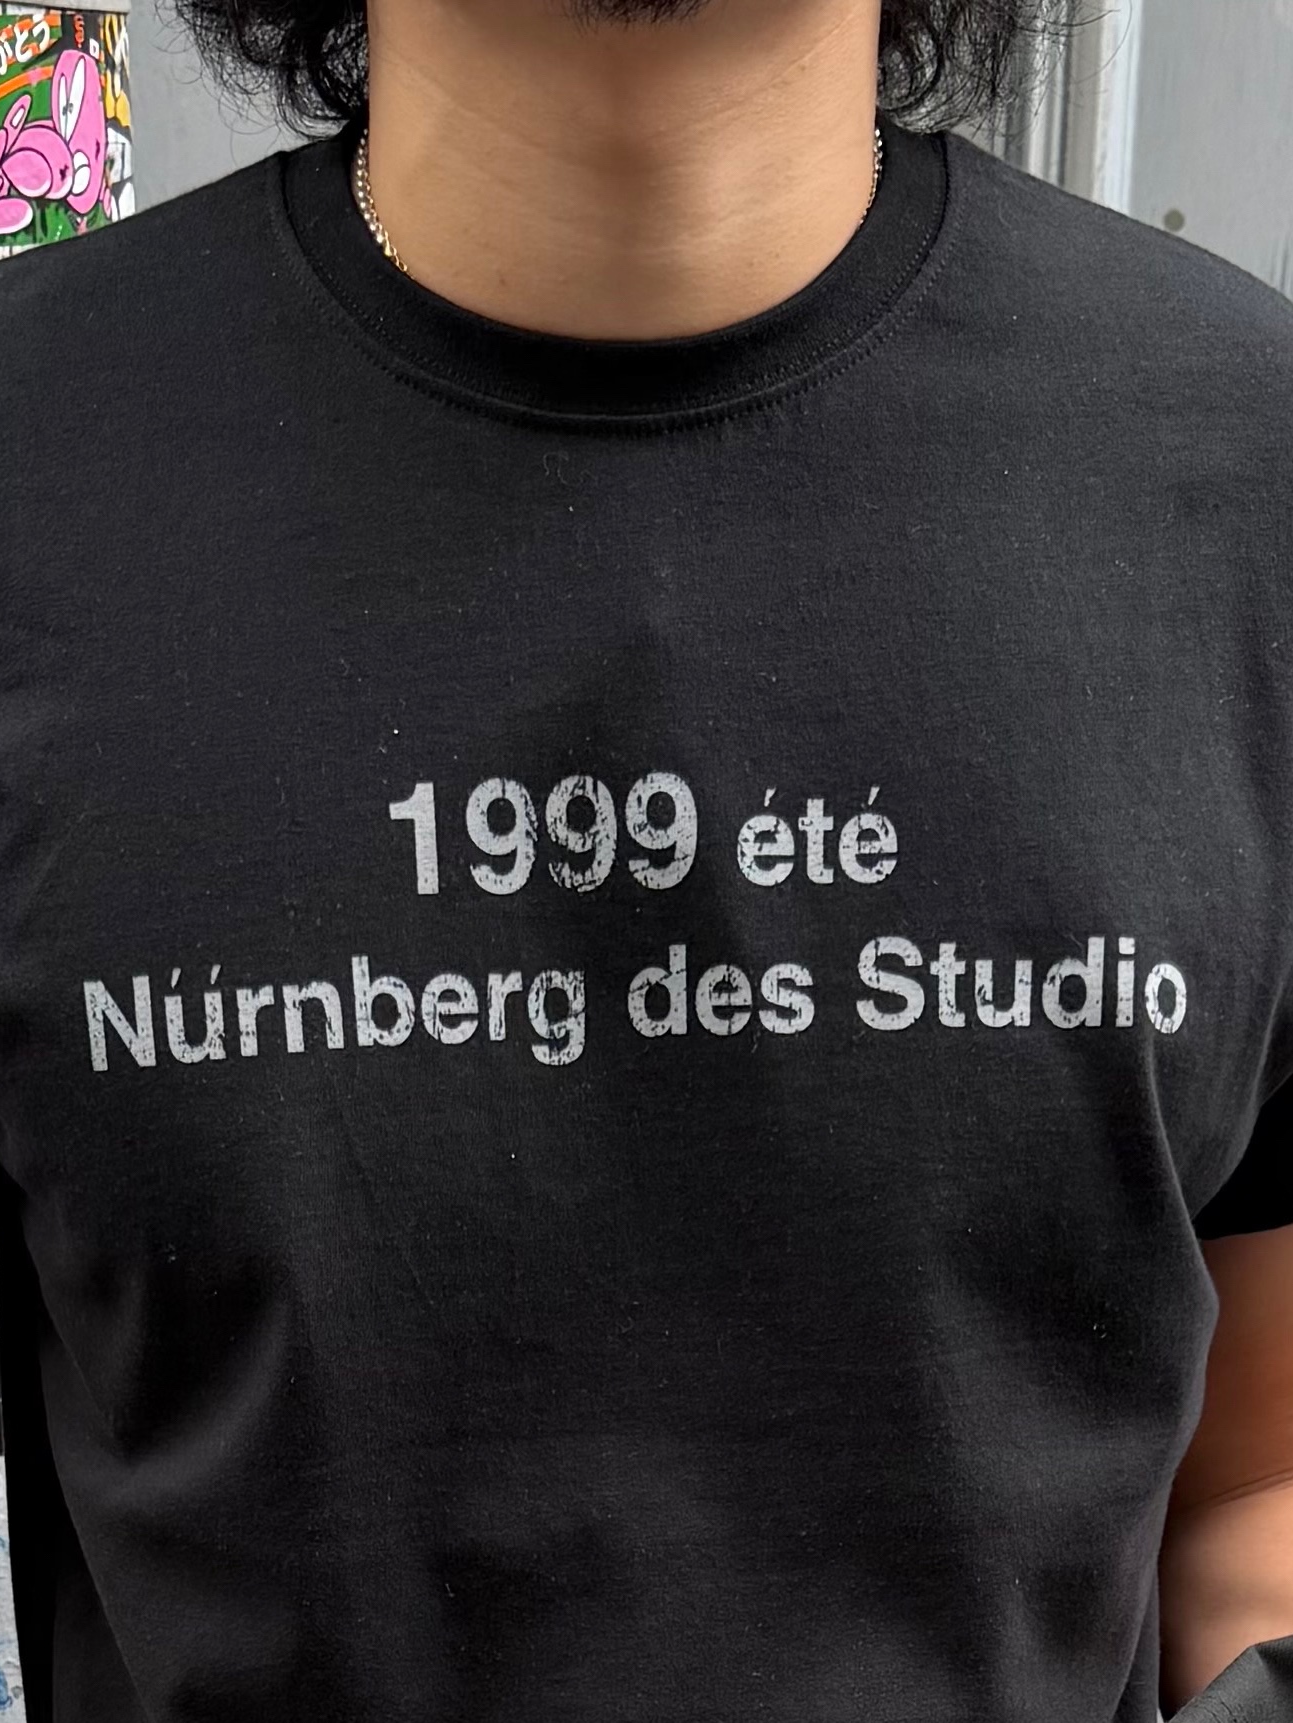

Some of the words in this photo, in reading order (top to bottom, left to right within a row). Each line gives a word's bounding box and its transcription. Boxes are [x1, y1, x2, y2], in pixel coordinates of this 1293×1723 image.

[388, 771, 698, 895] 1999
[736, 785, 899, 887] été
[627, 943, 816, 1038] des
[855, 935, 1188, 1034] Studio
